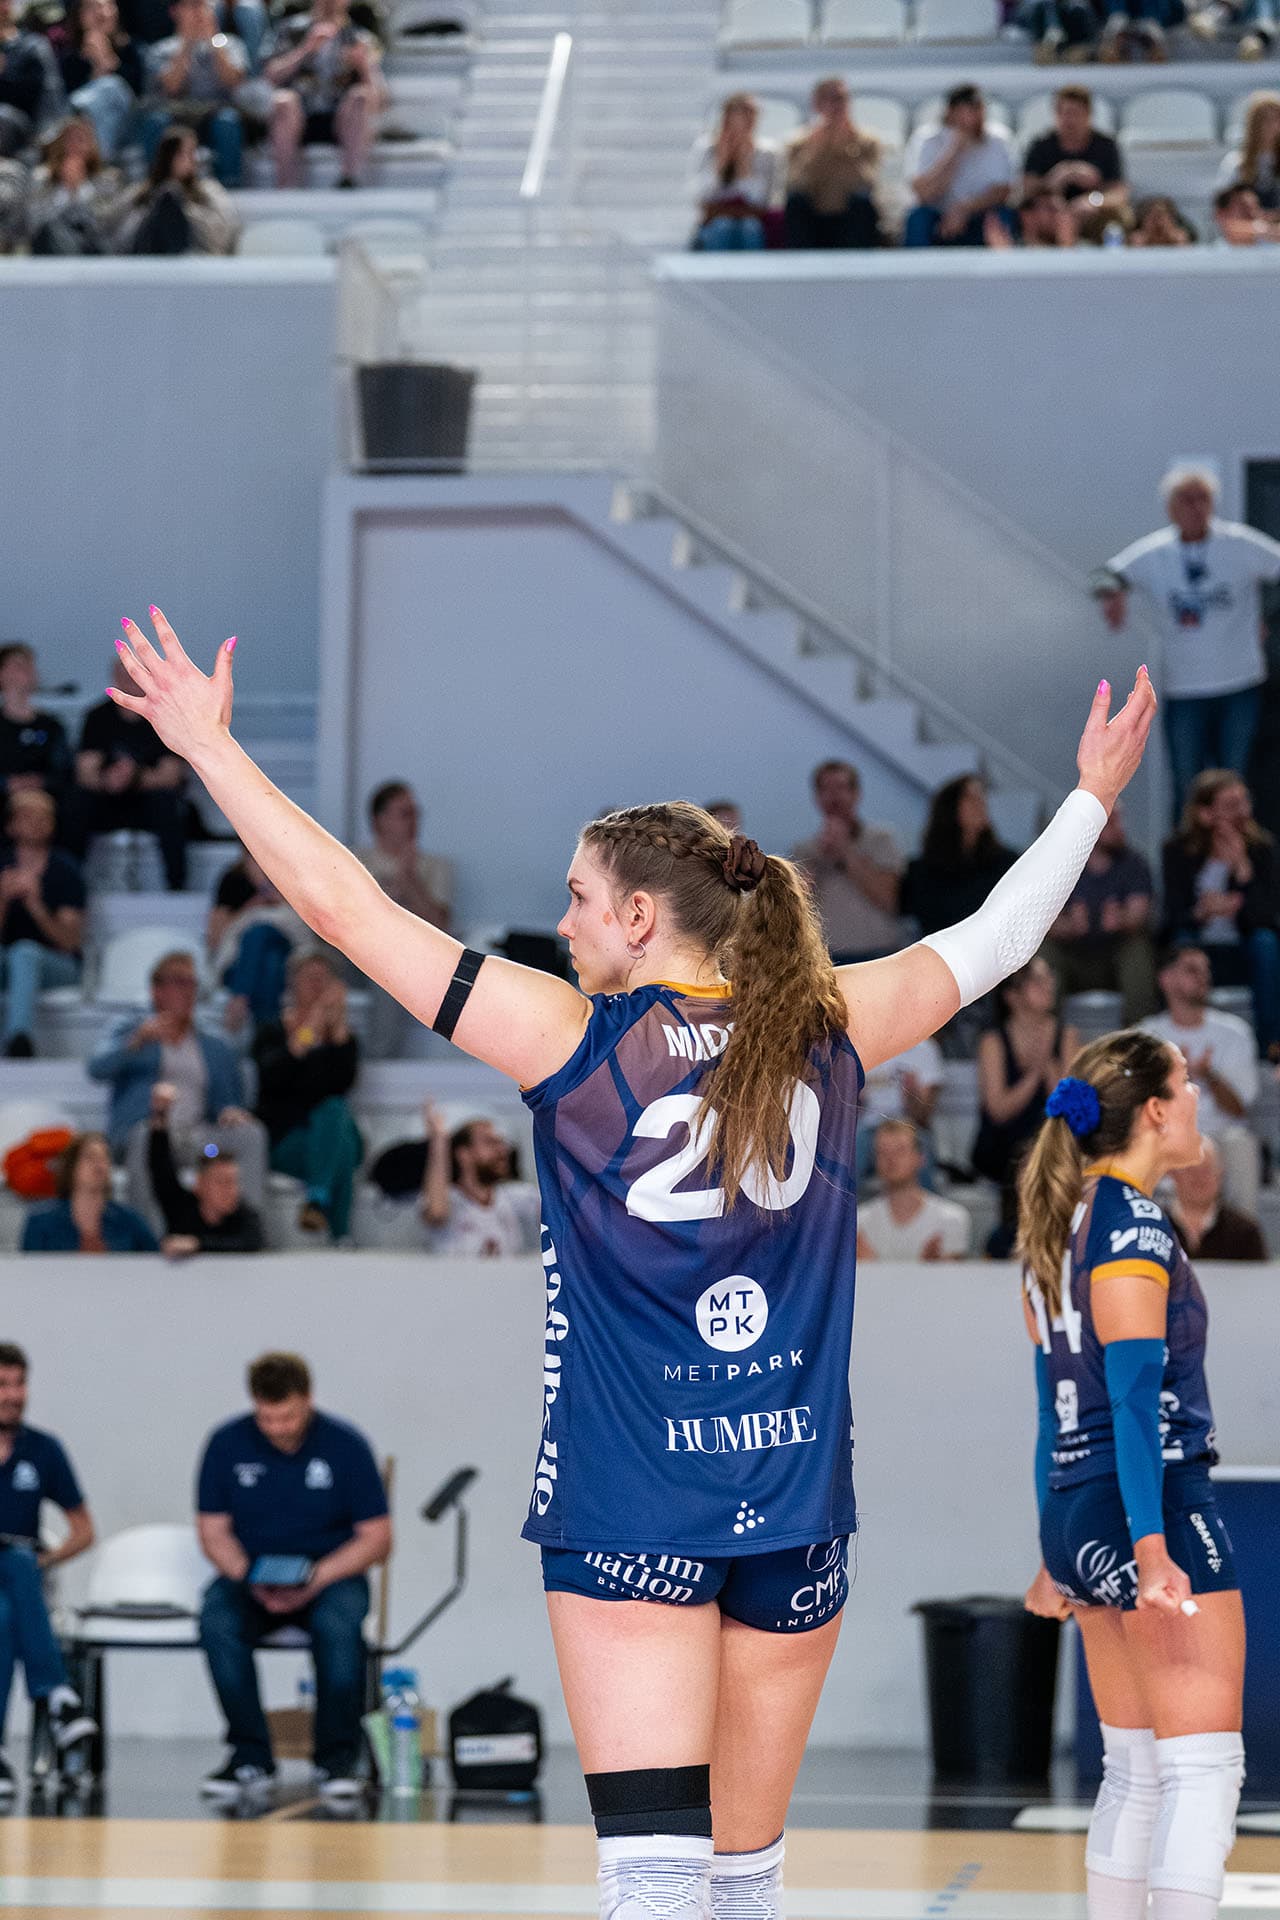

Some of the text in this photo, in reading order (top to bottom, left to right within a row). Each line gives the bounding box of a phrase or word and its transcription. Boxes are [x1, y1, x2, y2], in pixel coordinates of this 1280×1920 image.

[661, 1022, 736, 1061] MAD
[625, 1077, 820, 1222] 20
[710, 1290, 753, 1312] MT
[710, 1314, 754, 1337] PK
[664, 1349, 804, 1381] METPARK
[663, 1406, 817, 1453] HUMBEE
